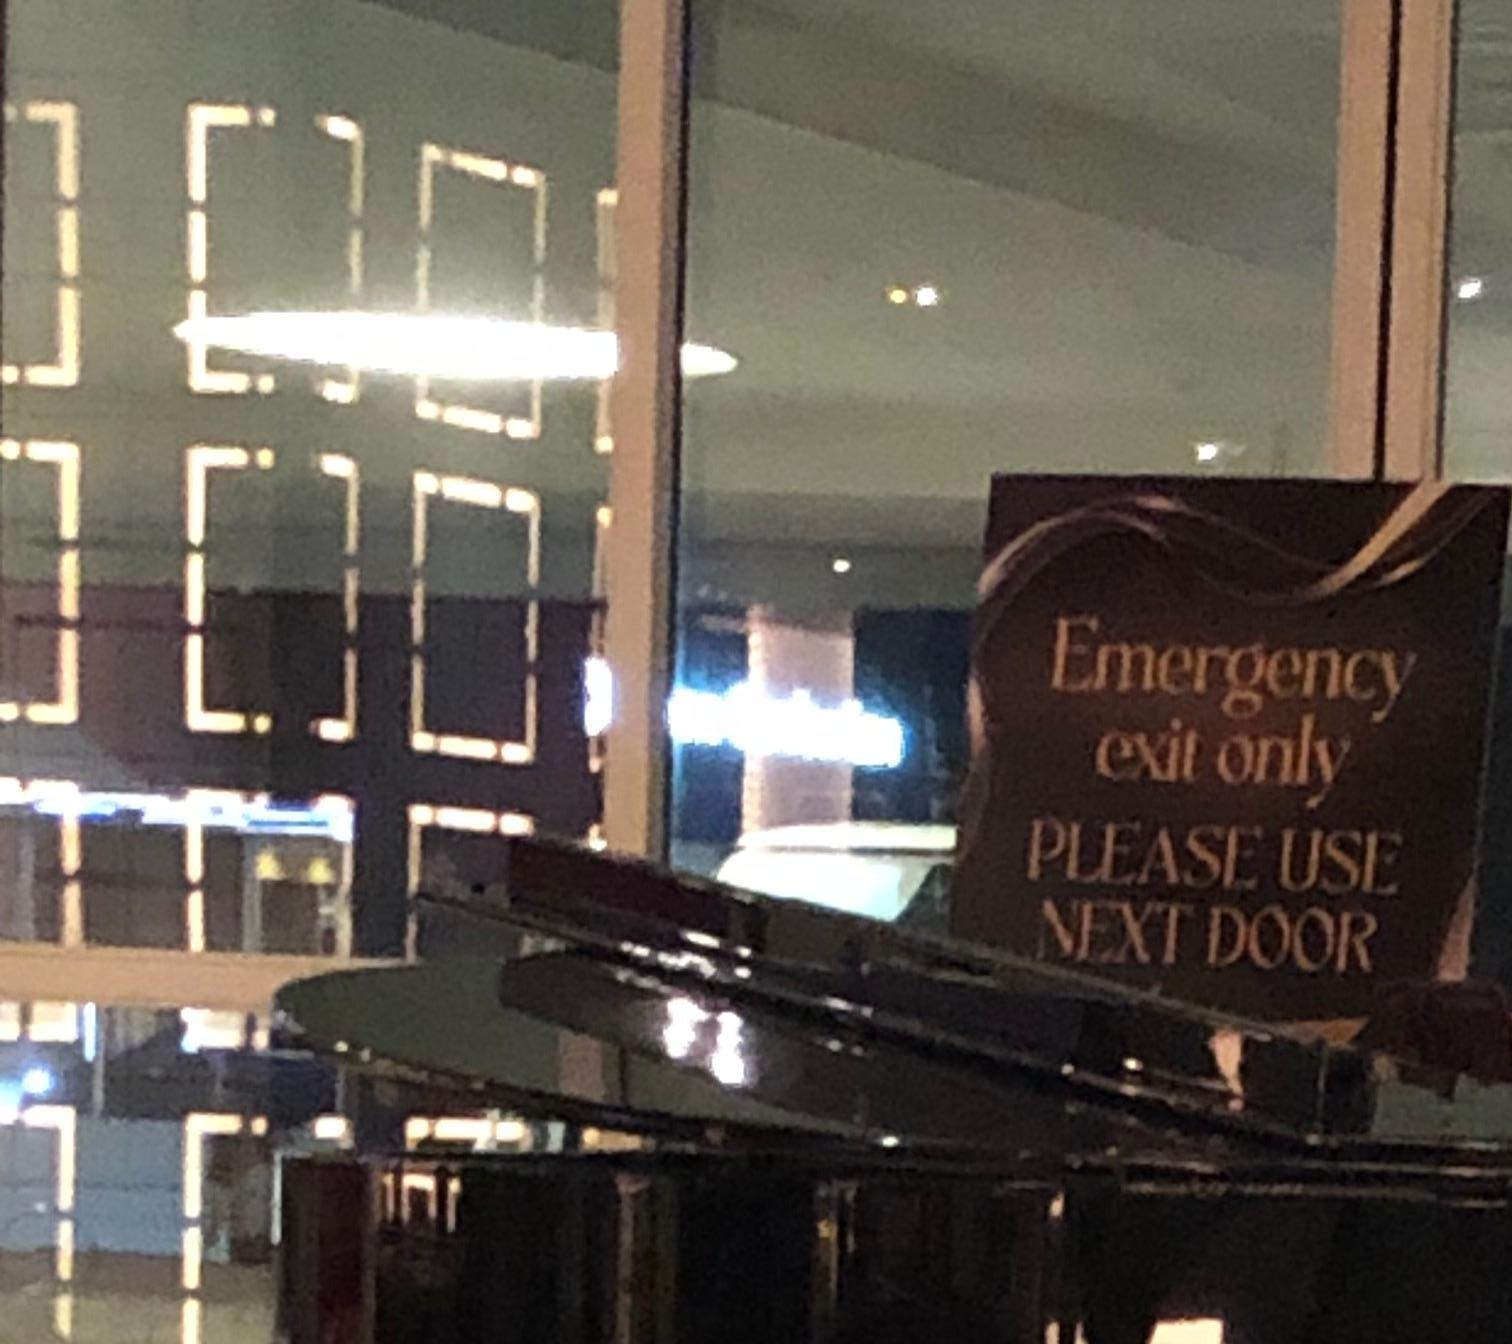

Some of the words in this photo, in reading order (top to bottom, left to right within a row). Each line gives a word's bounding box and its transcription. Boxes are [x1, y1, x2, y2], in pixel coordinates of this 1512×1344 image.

[1051, 616, 1417, 723] Emergency
[1096, 717, 1201, 782] exit
[1217, 713, 1350, 809] only
[1027, 817, 1262, 890] PLEASE
[1279, 826, 1402, 894] USE
[1036, 899, 1194, 966] NEXT
[1207, 904, 1379, 973] DOOR
